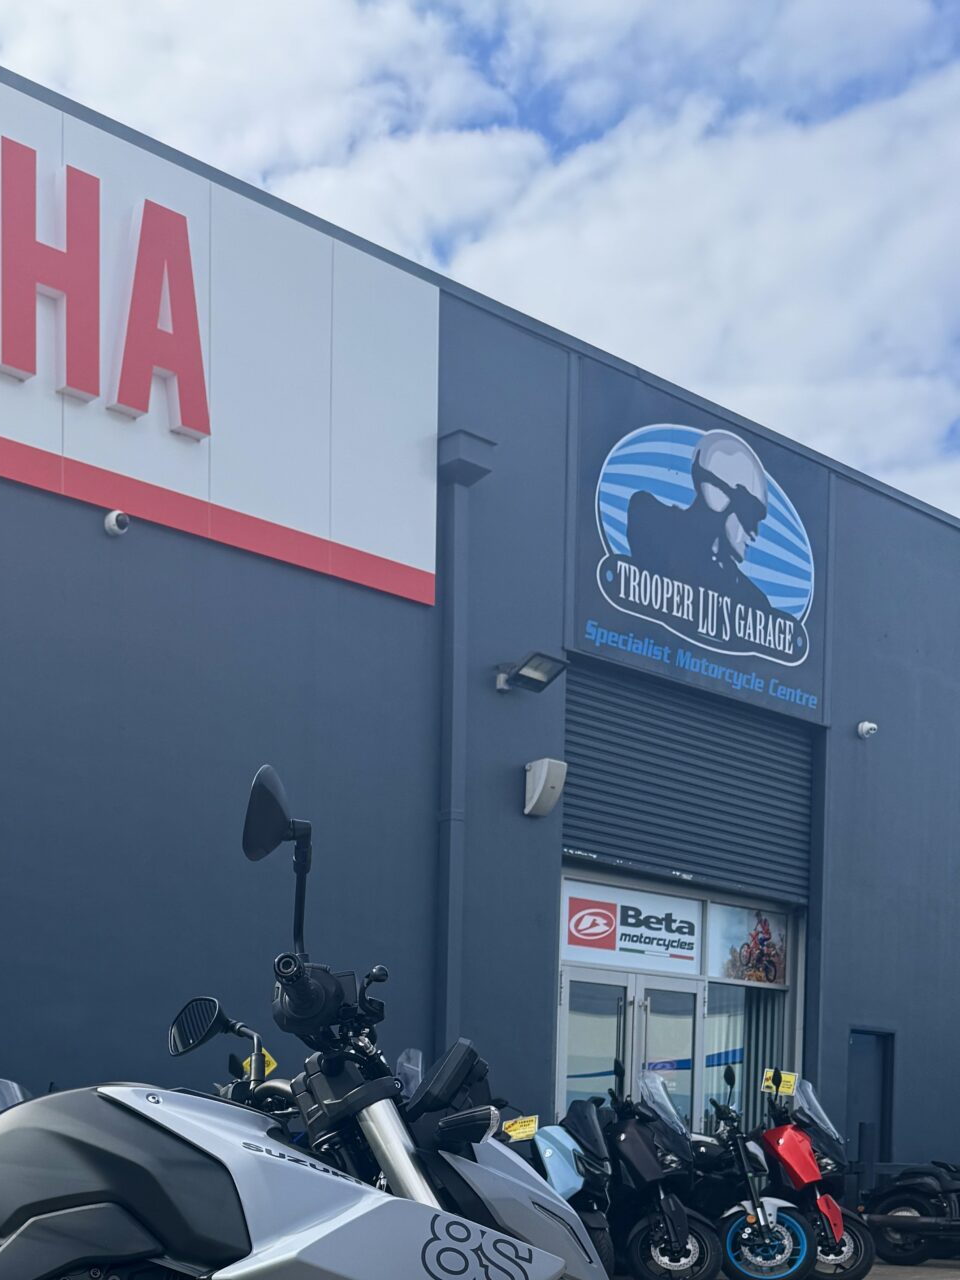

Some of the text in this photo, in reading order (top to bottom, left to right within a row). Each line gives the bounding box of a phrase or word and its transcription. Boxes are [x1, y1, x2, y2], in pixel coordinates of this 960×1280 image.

[617, 560, 794, 654] TROOPER LU'S GARAGE
[585, 620, 818, 709] Specialist Motorcycle Centre
[619, 932, 695, 951] motorcycles
[620, 904, 696, 937] Beta
